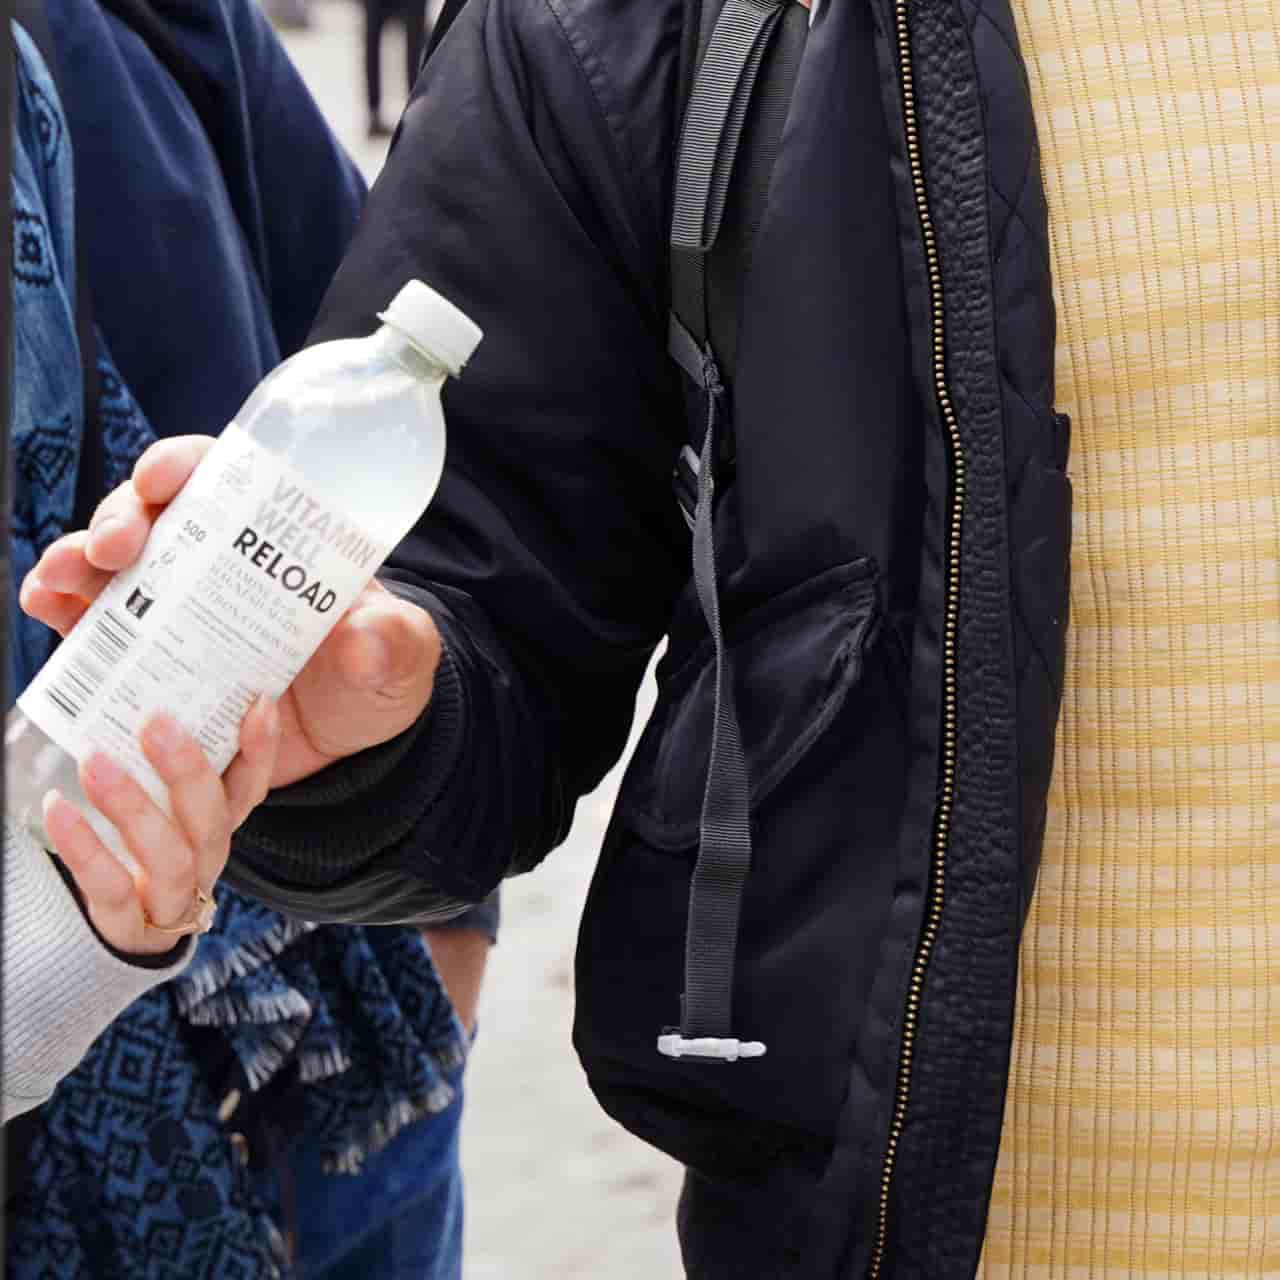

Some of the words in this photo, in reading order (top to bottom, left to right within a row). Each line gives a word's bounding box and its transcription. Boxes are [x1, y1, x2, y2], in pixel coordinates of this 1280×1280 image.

[182, 519, 207, 543] 500
[253, 498, 320, 569] WELL
[272, 475, 377, 569] VITAMIN
[232, 526, 337, 613] RELOAD
